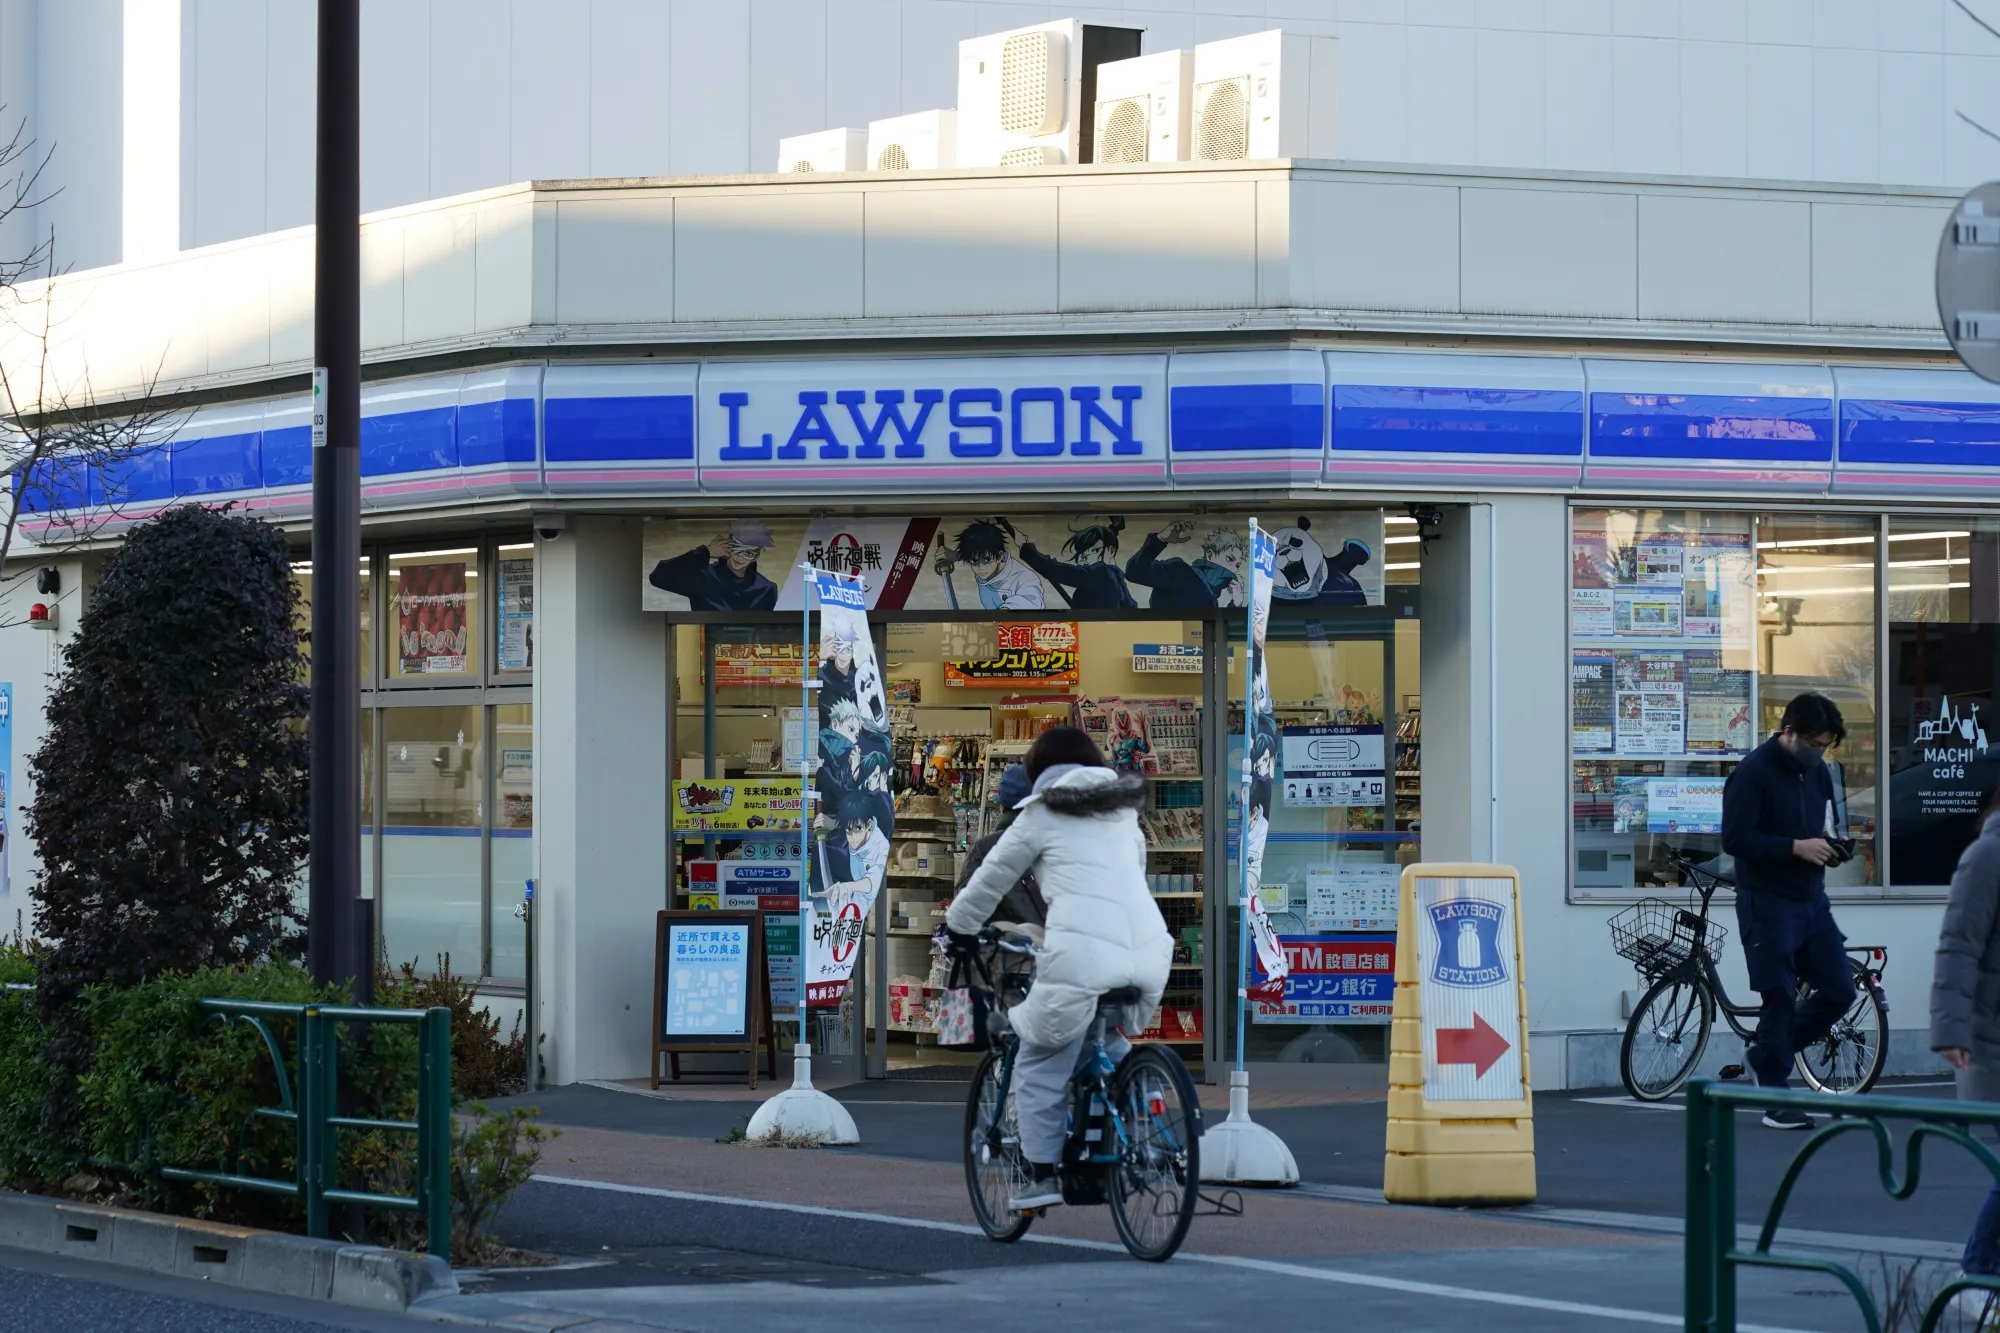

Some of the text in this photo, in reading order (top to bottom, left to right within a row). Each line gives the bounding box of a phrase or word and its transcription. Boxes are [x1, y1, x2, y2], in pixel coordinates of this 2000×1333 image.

[719, 386, 1143, 460] LAWSON
[817, 584, 865, 605] LAWSON
[1159, 645, 1203, 655] お酒コーナ
[1924, 748, 1973, 763] MACHI
[1933, 764, 1965, 778] café
[737, 868, 788, 877] ATMサービス
[1435, 904, 1499, 921] LAWSON
[677, 931, 741, 942] 近所で買える
[677, 944, 740, 954] 暮らしの良品
[1284, 948, 1389, 970] TM設置店舗
[1438, 966, 1500, 982] STATION
[1284, 978, 1377, 996] ローソン銀行
[1302, 1005, 1320, 1014] 出金
[1328, 1005, 1345, 1014] 入金
